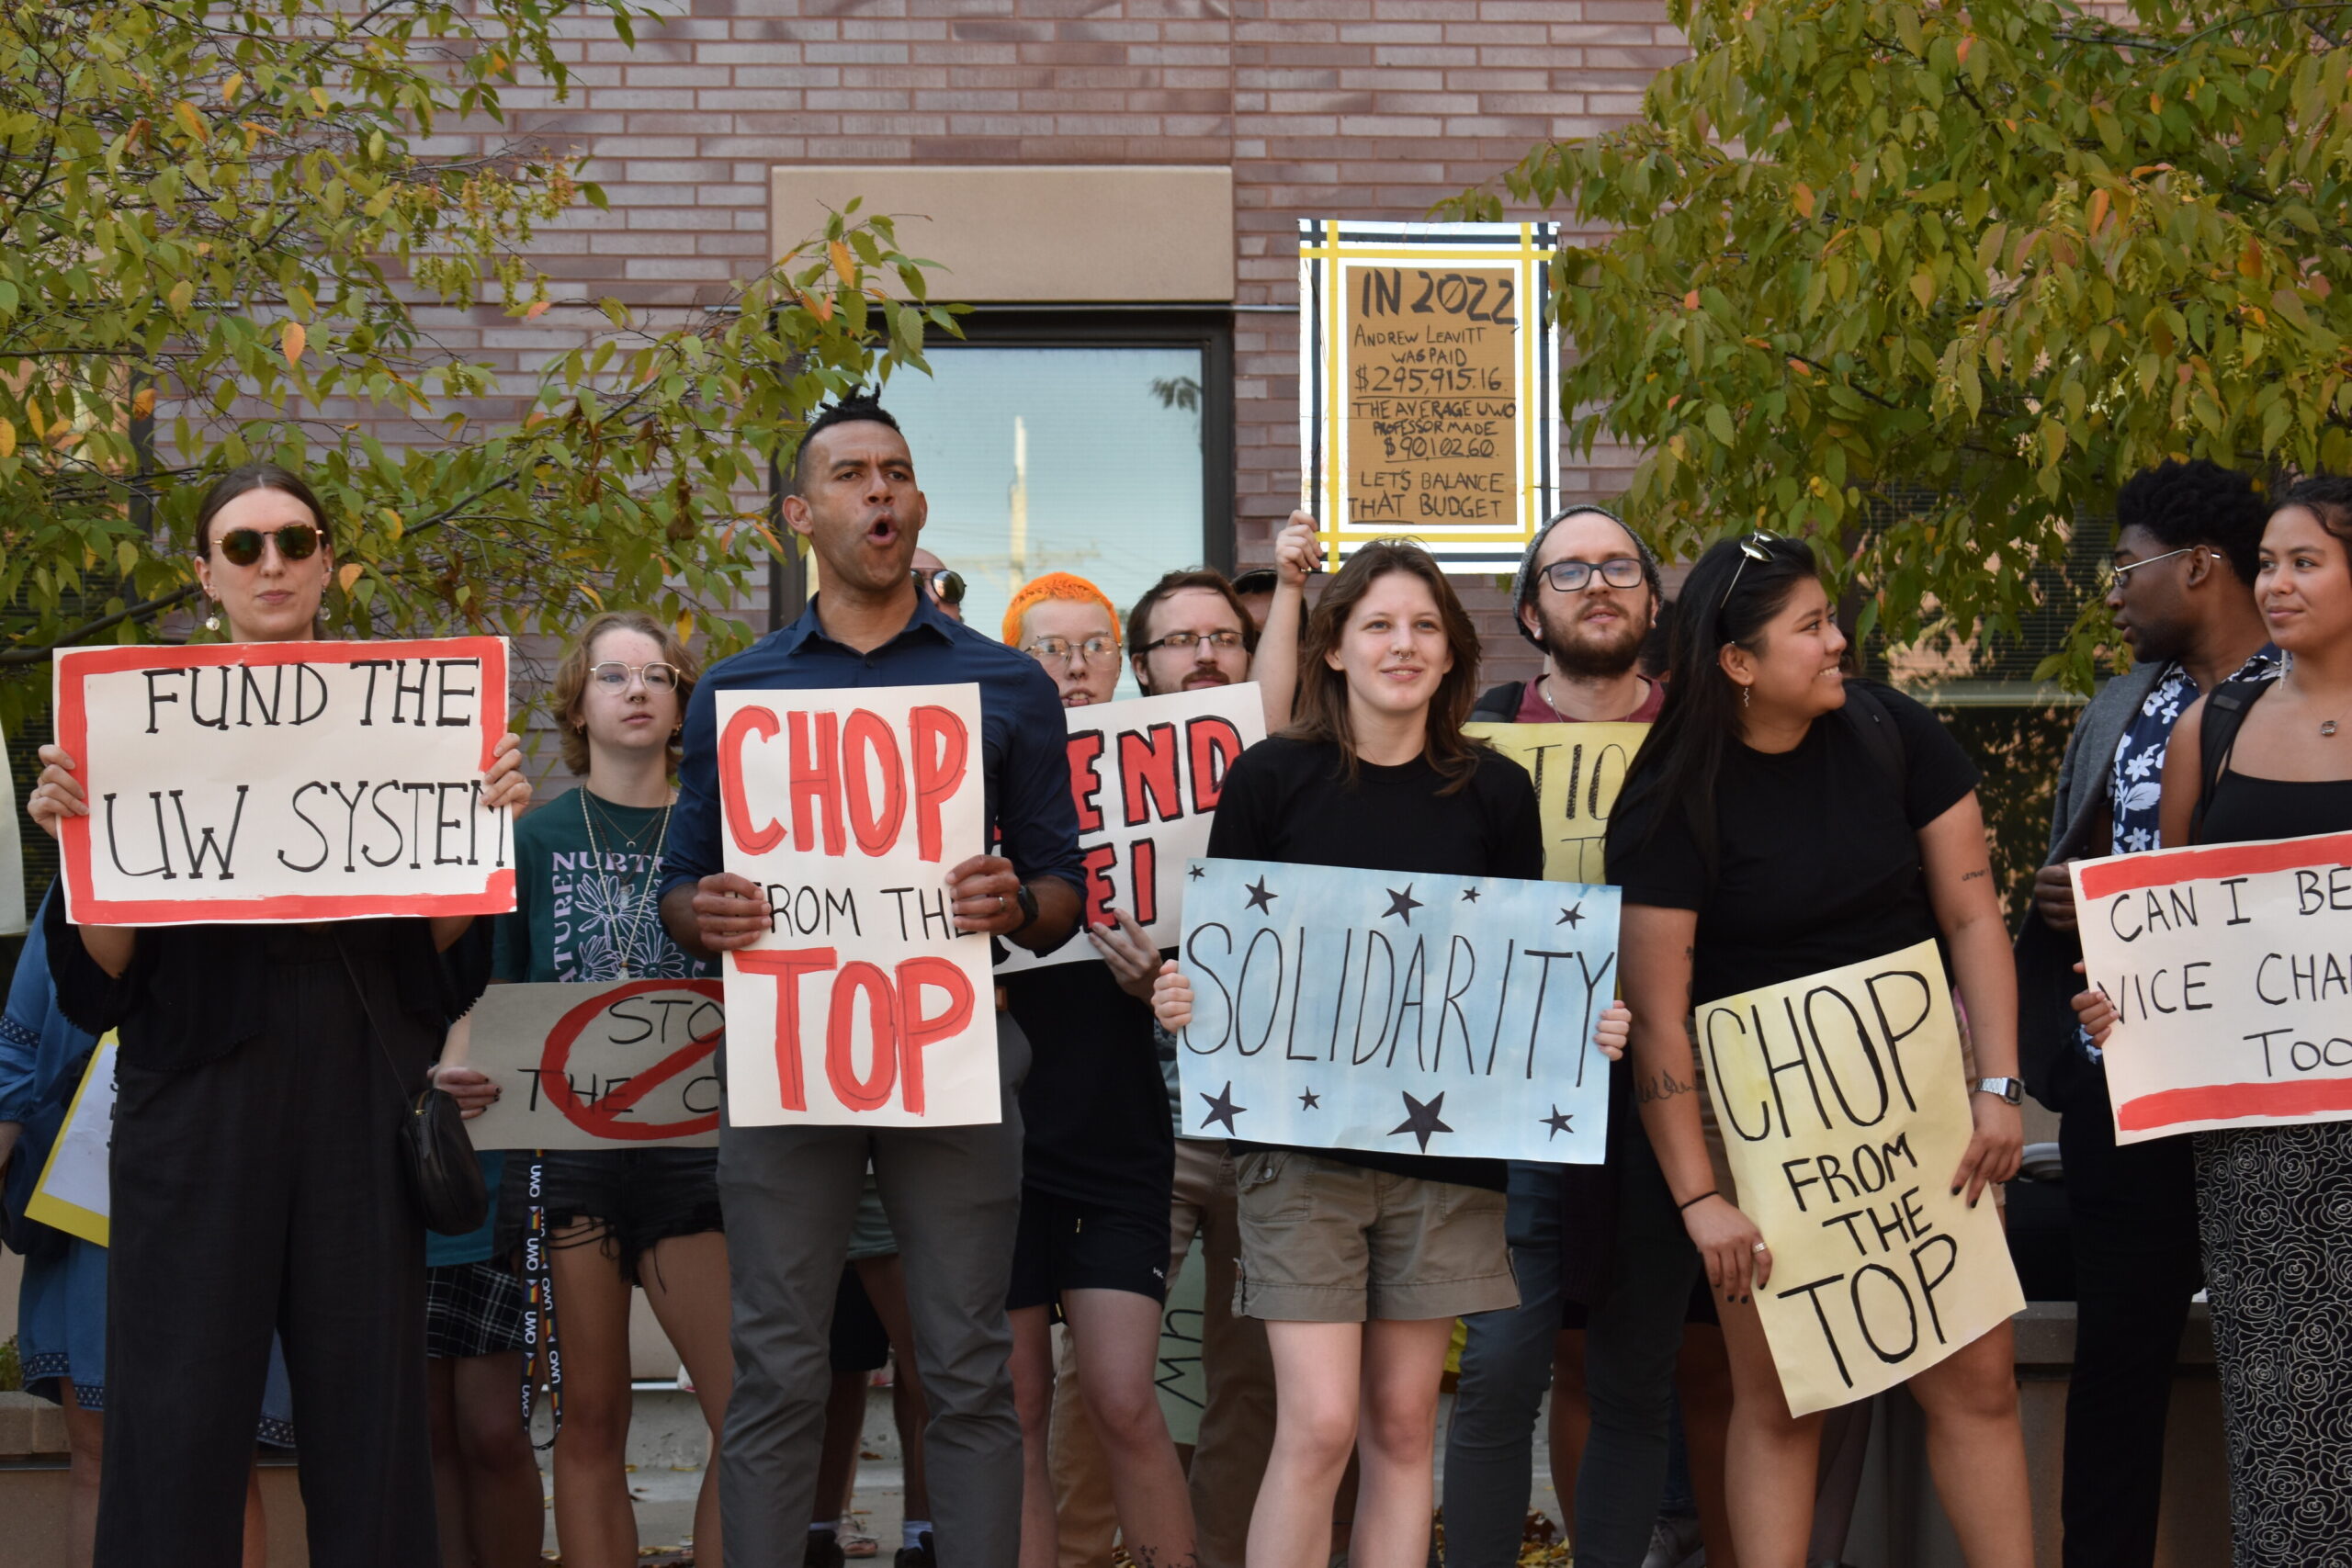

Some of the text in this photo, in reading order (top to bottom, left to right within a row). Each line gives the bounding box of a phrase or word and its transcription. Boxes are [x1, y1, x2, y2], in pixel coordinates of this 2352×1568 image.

[1363, 268, 1519, 325] IN 2022
[1354, 323, 1487, 347] ANDREW LEAVITT
[1430, 347, 1467, 367] PAID
[1351, 400, 1517, 420] THE AVERAGE UWO
[1447, 421, 1498, 436] MADE
[1348, 490, 1502, 519] THAT BUDGET
[1361, 468, 1505, 493] LET'S BALANCE
[141, 658, 480, 734] FUND THE
[718, 705, 969, 863] CHOP
[103, 779, 506, 880] UW SYSTEM
[736, 882, 862, 937] ROM
[2110, 866, 2352, 942] CAN I BE
[1182, 922, 1615, 1088] SOLIDARITY
[2096, 961, 2213, 1024] VICE
[735, 946, 976, 1117] TOP
[1705, 970, 1931, 1142] CHOP
[2243, 1028, 2352, 1077] TOO
[517, 1068, 634, 1114] THE
[529, 1165, 543, 1198] UWO
[1781, 1131, 1918, 1212] FROM
[1821, 1185, 1933, 1256] THE
[526, 1237, 539, 1272] UWO
[541, 1277, 553, 1311] UWO
[1776, 1233, 1958, 1389] TOP
[525, 1311, 537, 1344] UWO
[548, 1350, 560, 1384] UWO
[523, 1384, 531, 1417] UWO
